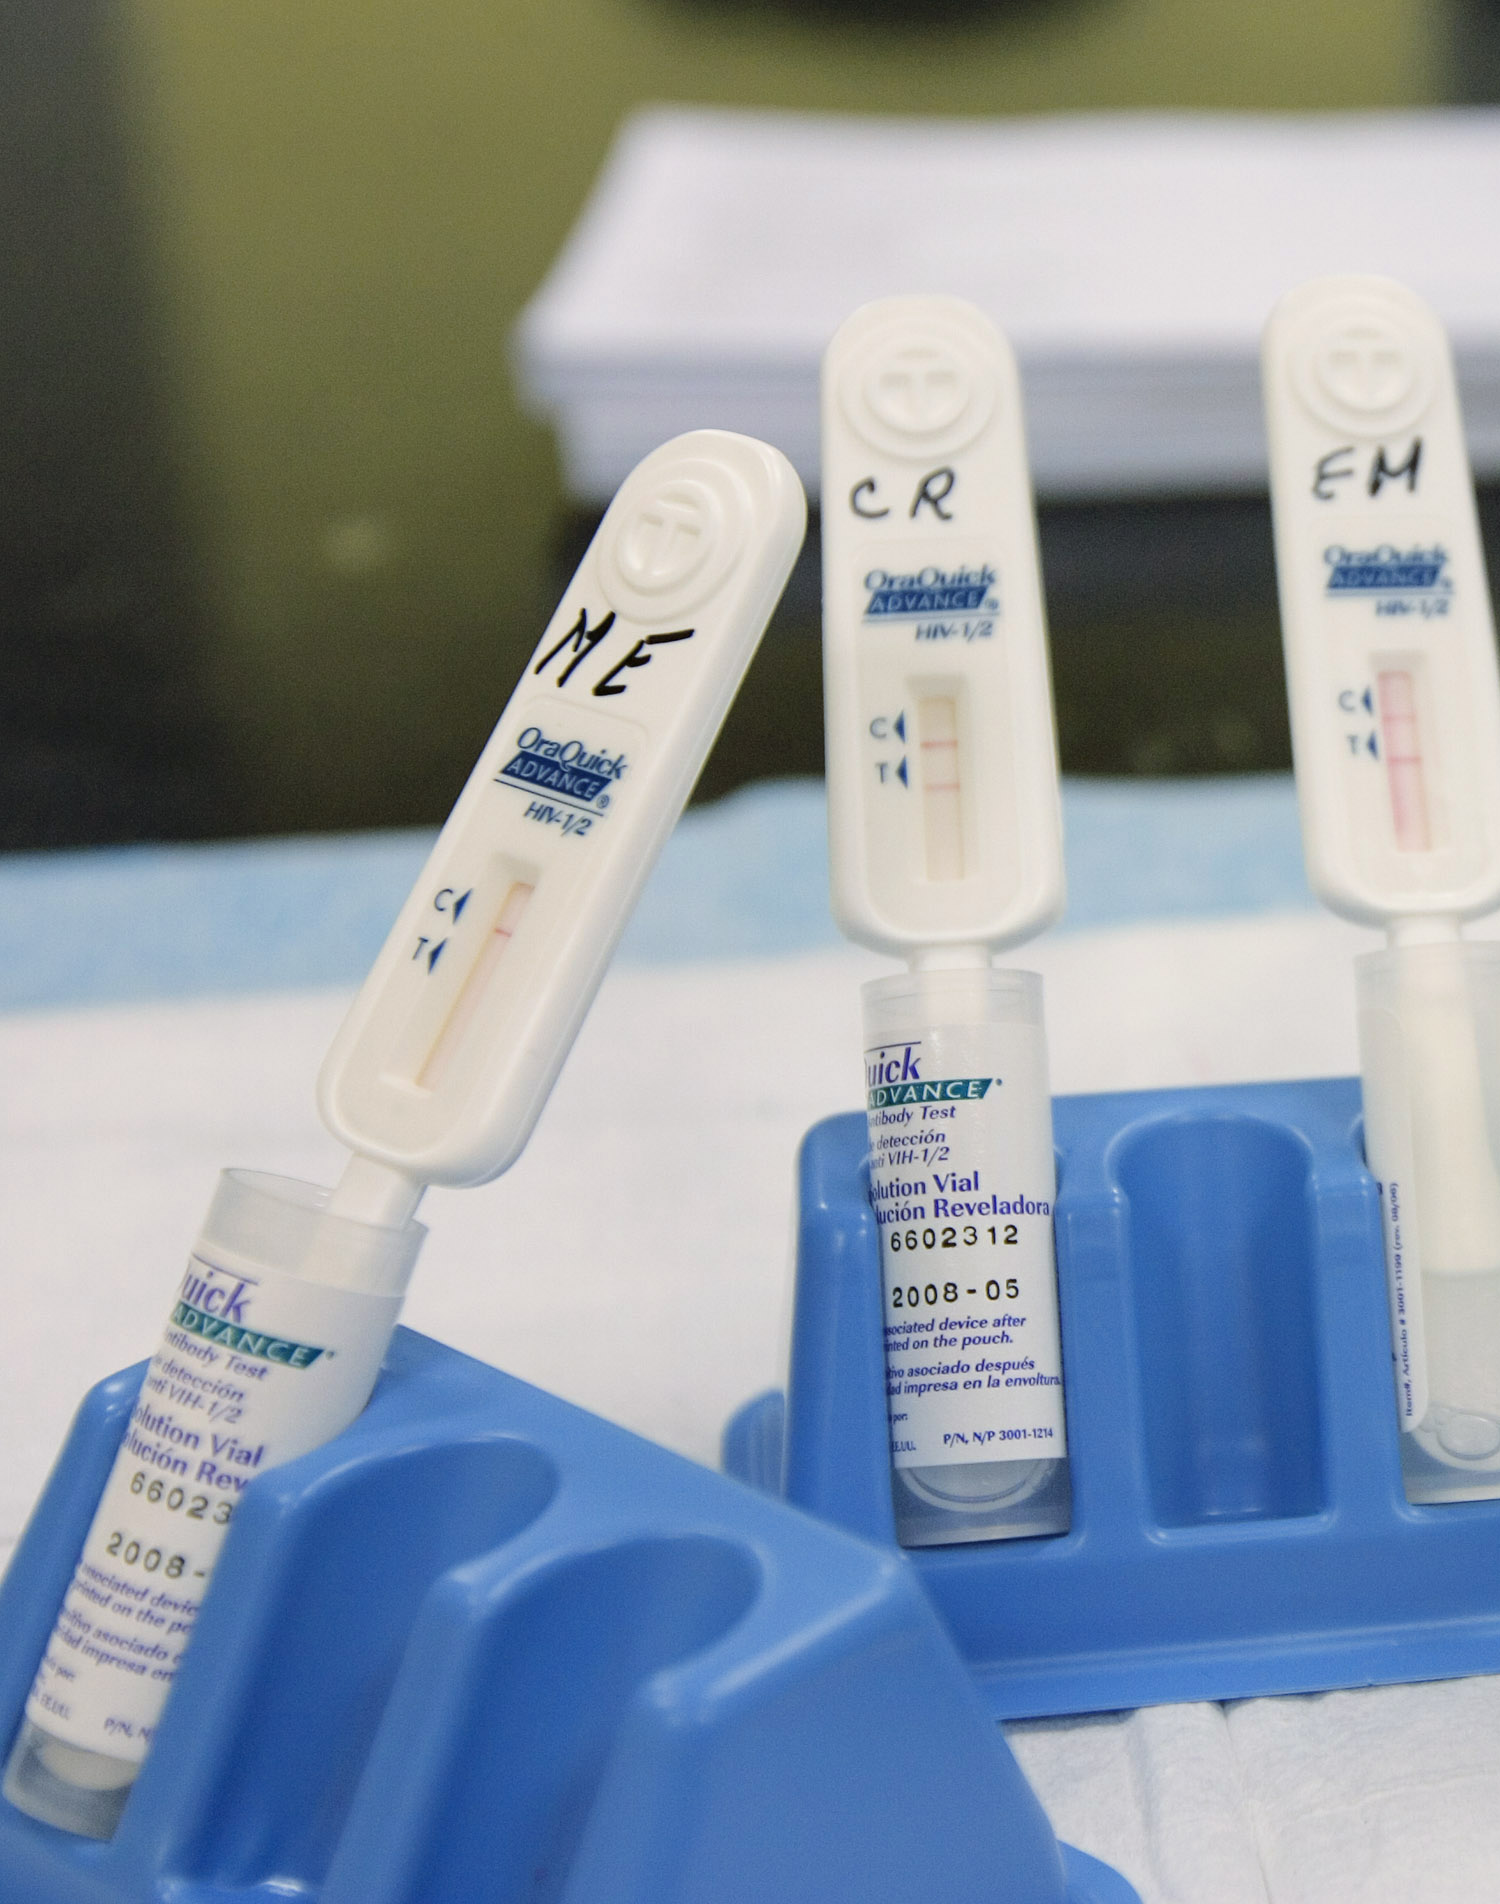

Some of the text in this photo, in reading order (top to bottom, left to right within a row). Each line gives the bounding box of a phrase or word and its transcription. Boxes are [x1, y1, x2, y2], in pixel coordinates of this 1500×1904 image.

[1313, 437, 1422, 500] EM
[850, 466, 956, 520] CR
[863, 564, 997, 590] OraQuick
[915, 620, 993, 641] HIV-1/2
[534, 607, 695, 697] ME
[1338, 690, 1355, 713] C
[869, 716, 887, 739] C
[516, 727, 628, 780] OraQuick
[876, 762, 888, 784] T
[523, 801, 593, 837] HIV-1/2
[434, 888, 454, 912] C
[411, 936, 429, 961] T
[864, 1047, 921, 1087] uick
[920, 1105, 956, 1121] Test
[877, 1129, 946, 1150] detección
[888, 1147, 950, 1167] VIH-1/2
[933, 1171, 979, 1193] Vial
[934, 1194, 1050, 1219] Reveladora
[890, 1225, 1018, 1252] 6602312
[892, 1278, 1020, 1308] 2008-05
[939, 1316, 988, 1331] device
[992, 1314, 1026, 1329] after
[912, 1337, 929, 1350] on
[934, 1334, 957, 1348] the
[961, 1331, 1014, 1350] pouch.
[224, 1355, 268, 1381] Test
[907, 1357, 1035, 1377] asociado después
[162, 1359, 244, 1402] detección
[904, 1371, 1061, 1398] impresa en la envoltura.
[169, 1384, 245, 1425] VIH-1/2
[210, 1433, 265, 1468] Vial
[943, 1428, 1053, 1448] P/N, N/P 3001-1214
[130, 1471, 233, 1525] 66023
[112, 1602, 165, 1628] on the
[81, 1640, 147, 1676] impresa
[93, 1630, 168, 1661] asociado
